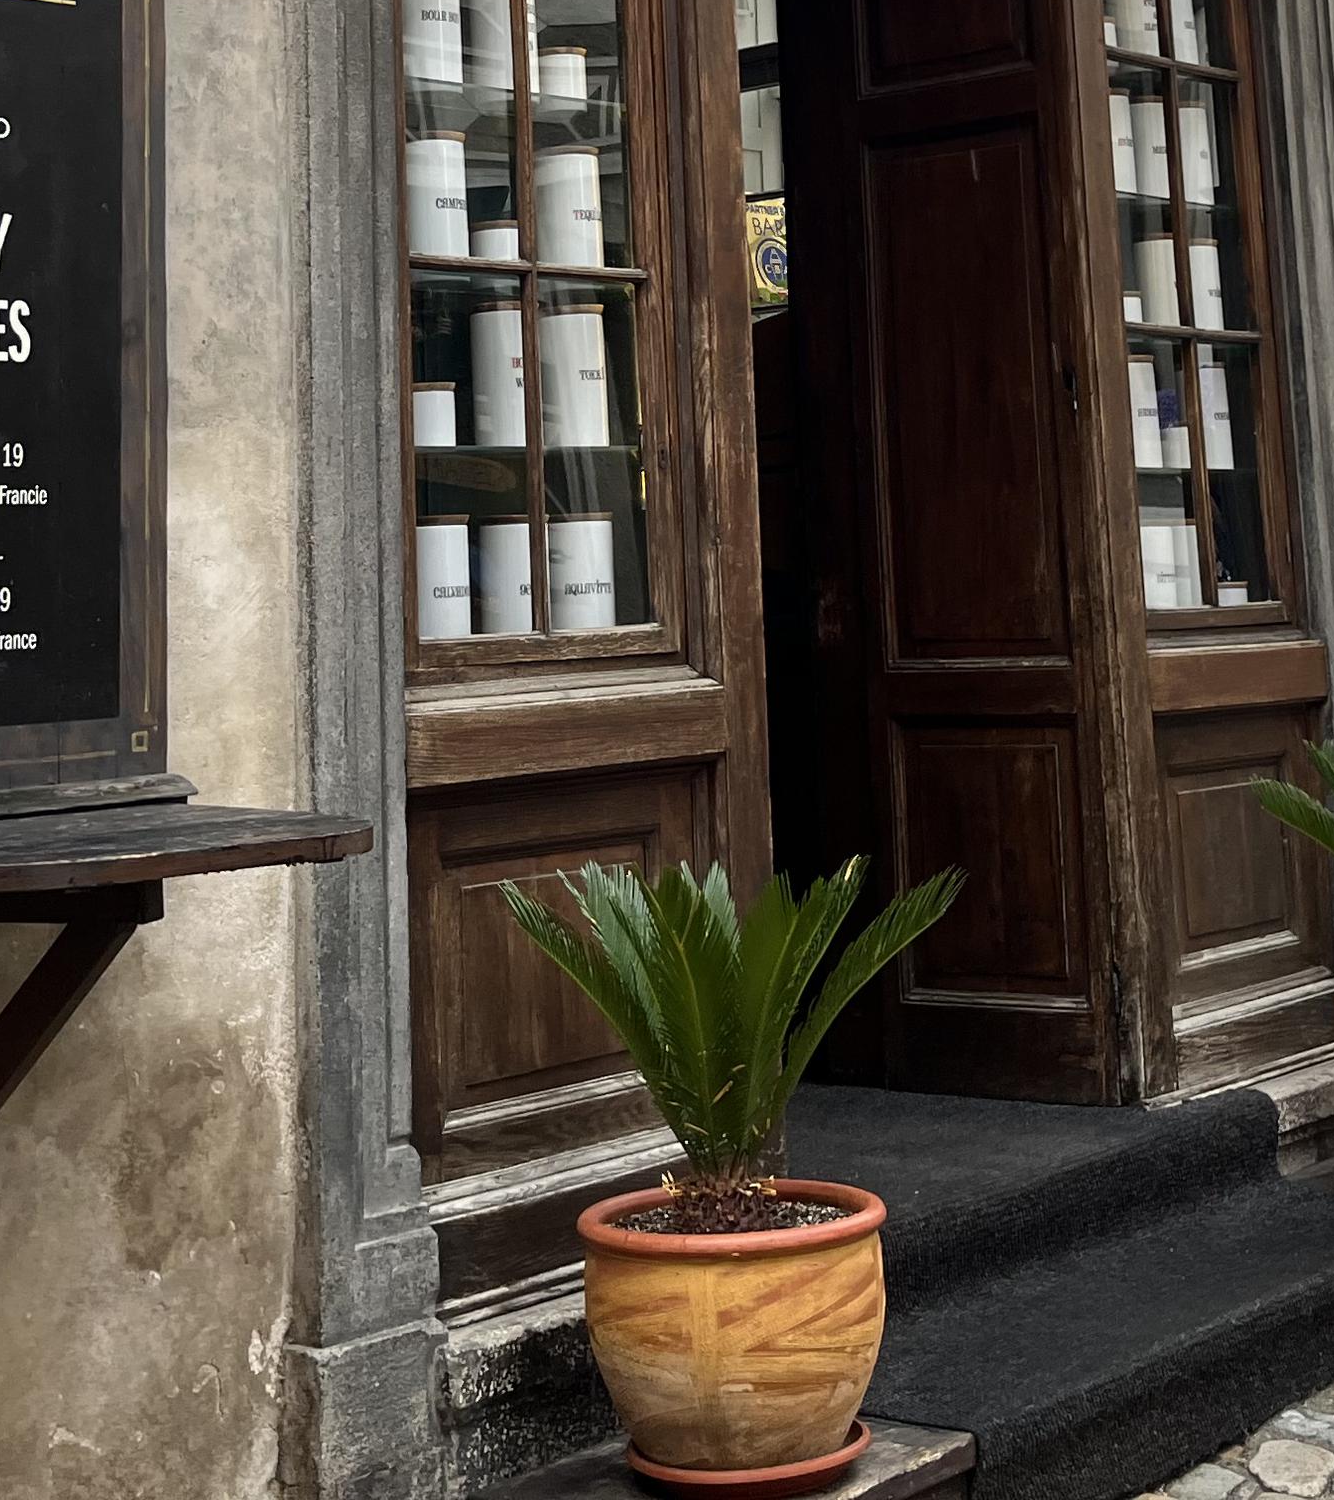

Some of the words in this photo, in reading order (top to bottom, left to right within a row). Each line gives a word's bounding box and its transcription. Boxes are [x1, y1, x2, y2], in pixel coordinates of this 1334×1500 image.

[752, 217, 785, 237] BAR
[3, 443, 24, 467] 19
[0, 484, 48, 505] Francie
